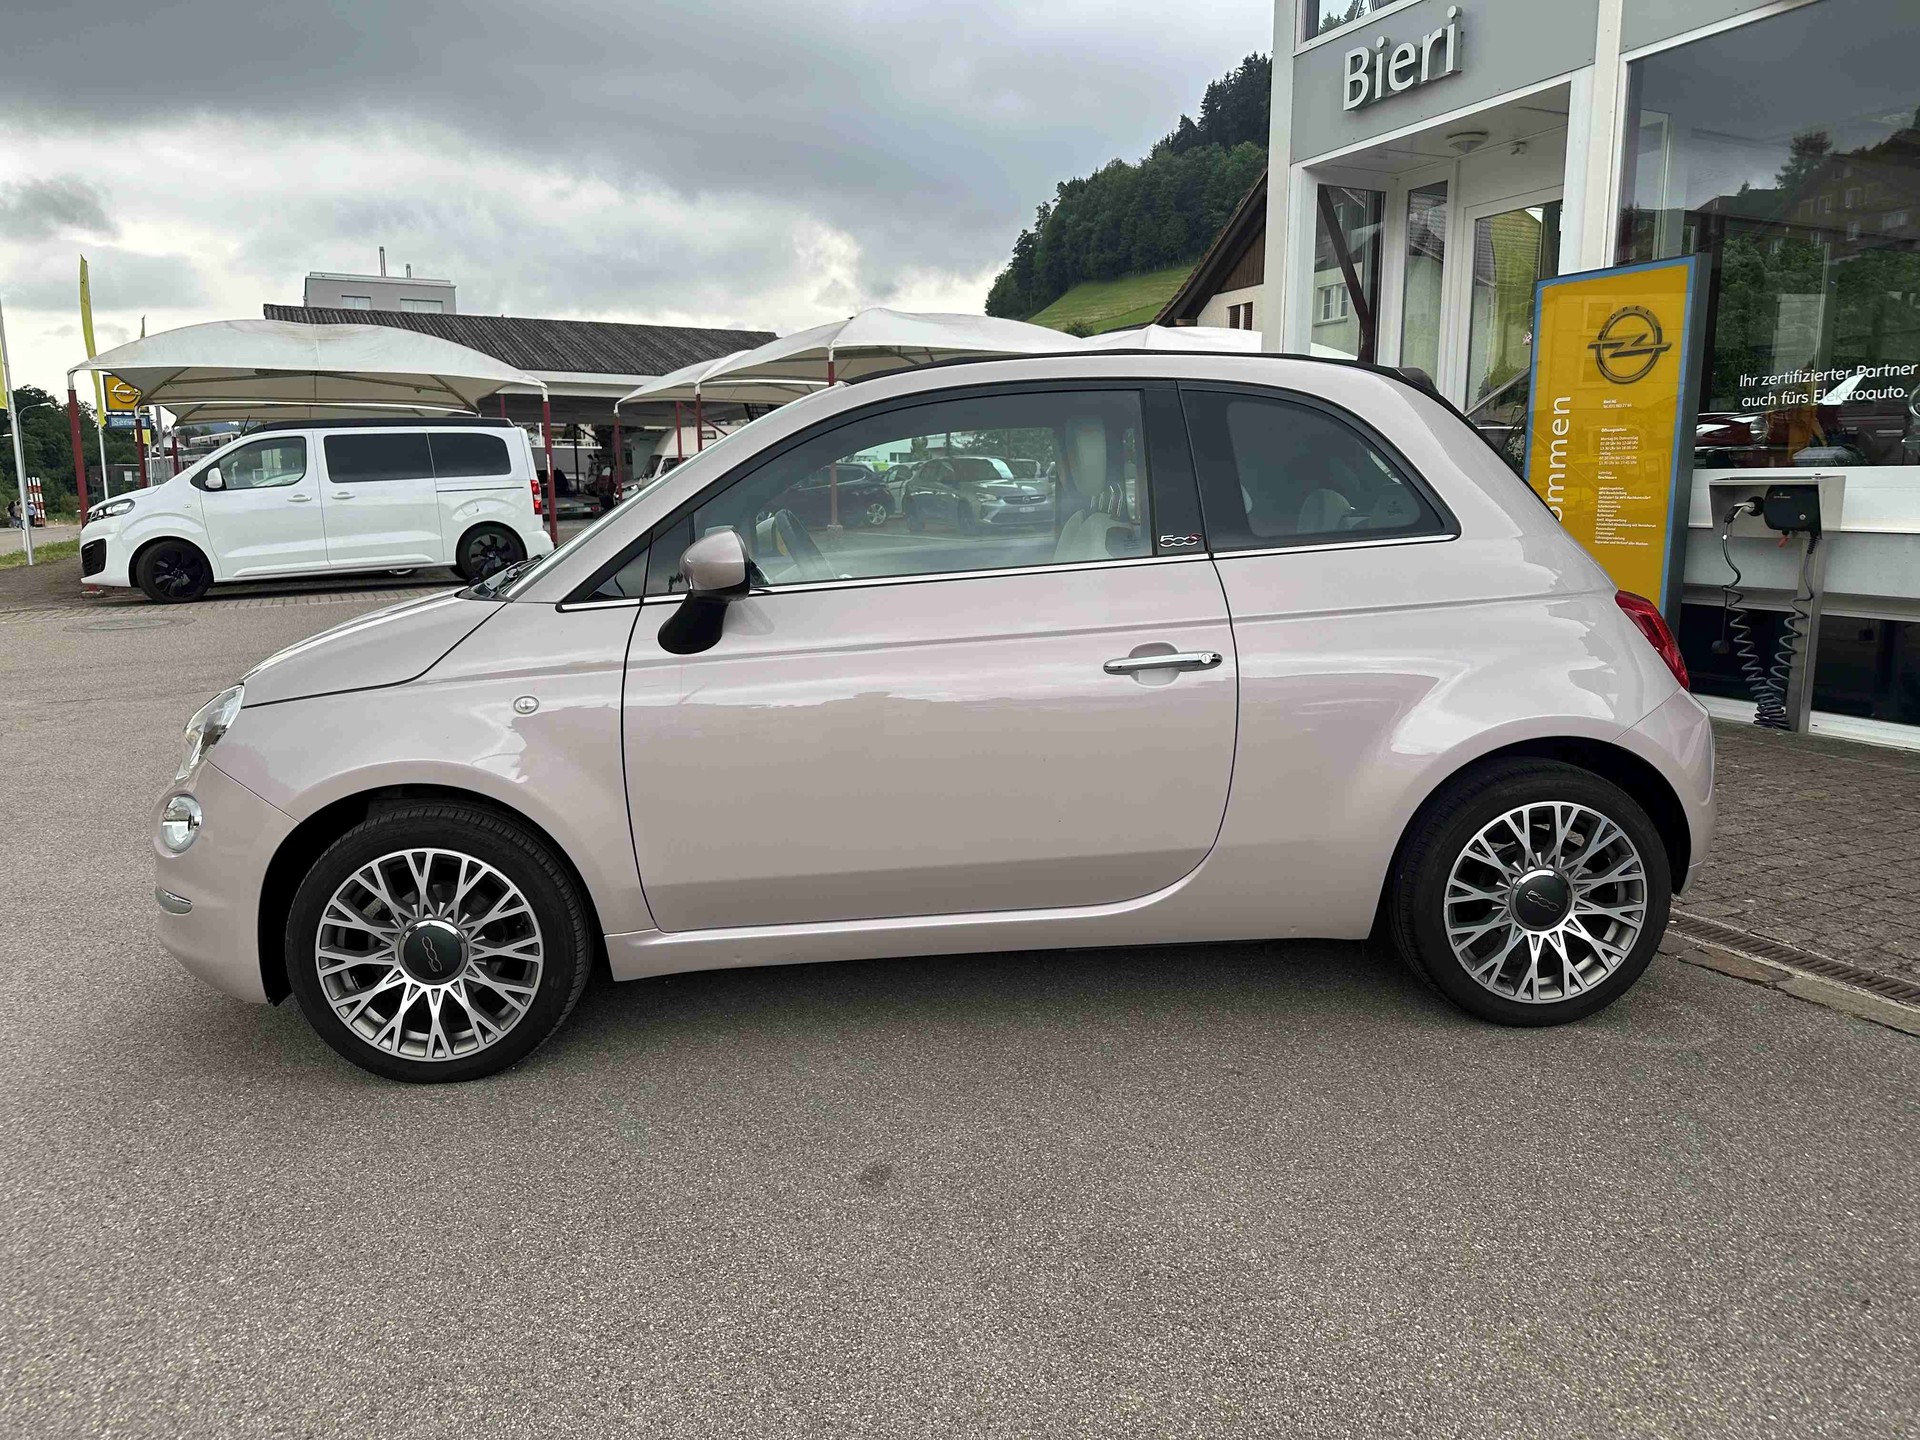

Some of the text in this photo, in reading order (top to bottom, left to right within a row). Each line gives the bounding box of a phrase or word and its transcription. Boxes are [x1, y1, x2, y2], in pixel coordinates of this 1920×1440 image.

[1343, 5, 1462, 111] Bieri
[1610, 305, 1650, 320] OPEL
[1740, 363, 1919, 387] Ihr zertifizierter Partner
[1741, 390, 1776, 407] auch
[1781, 389, 1809, 405] fürs
[1160, 534, 1198, 548] 500
